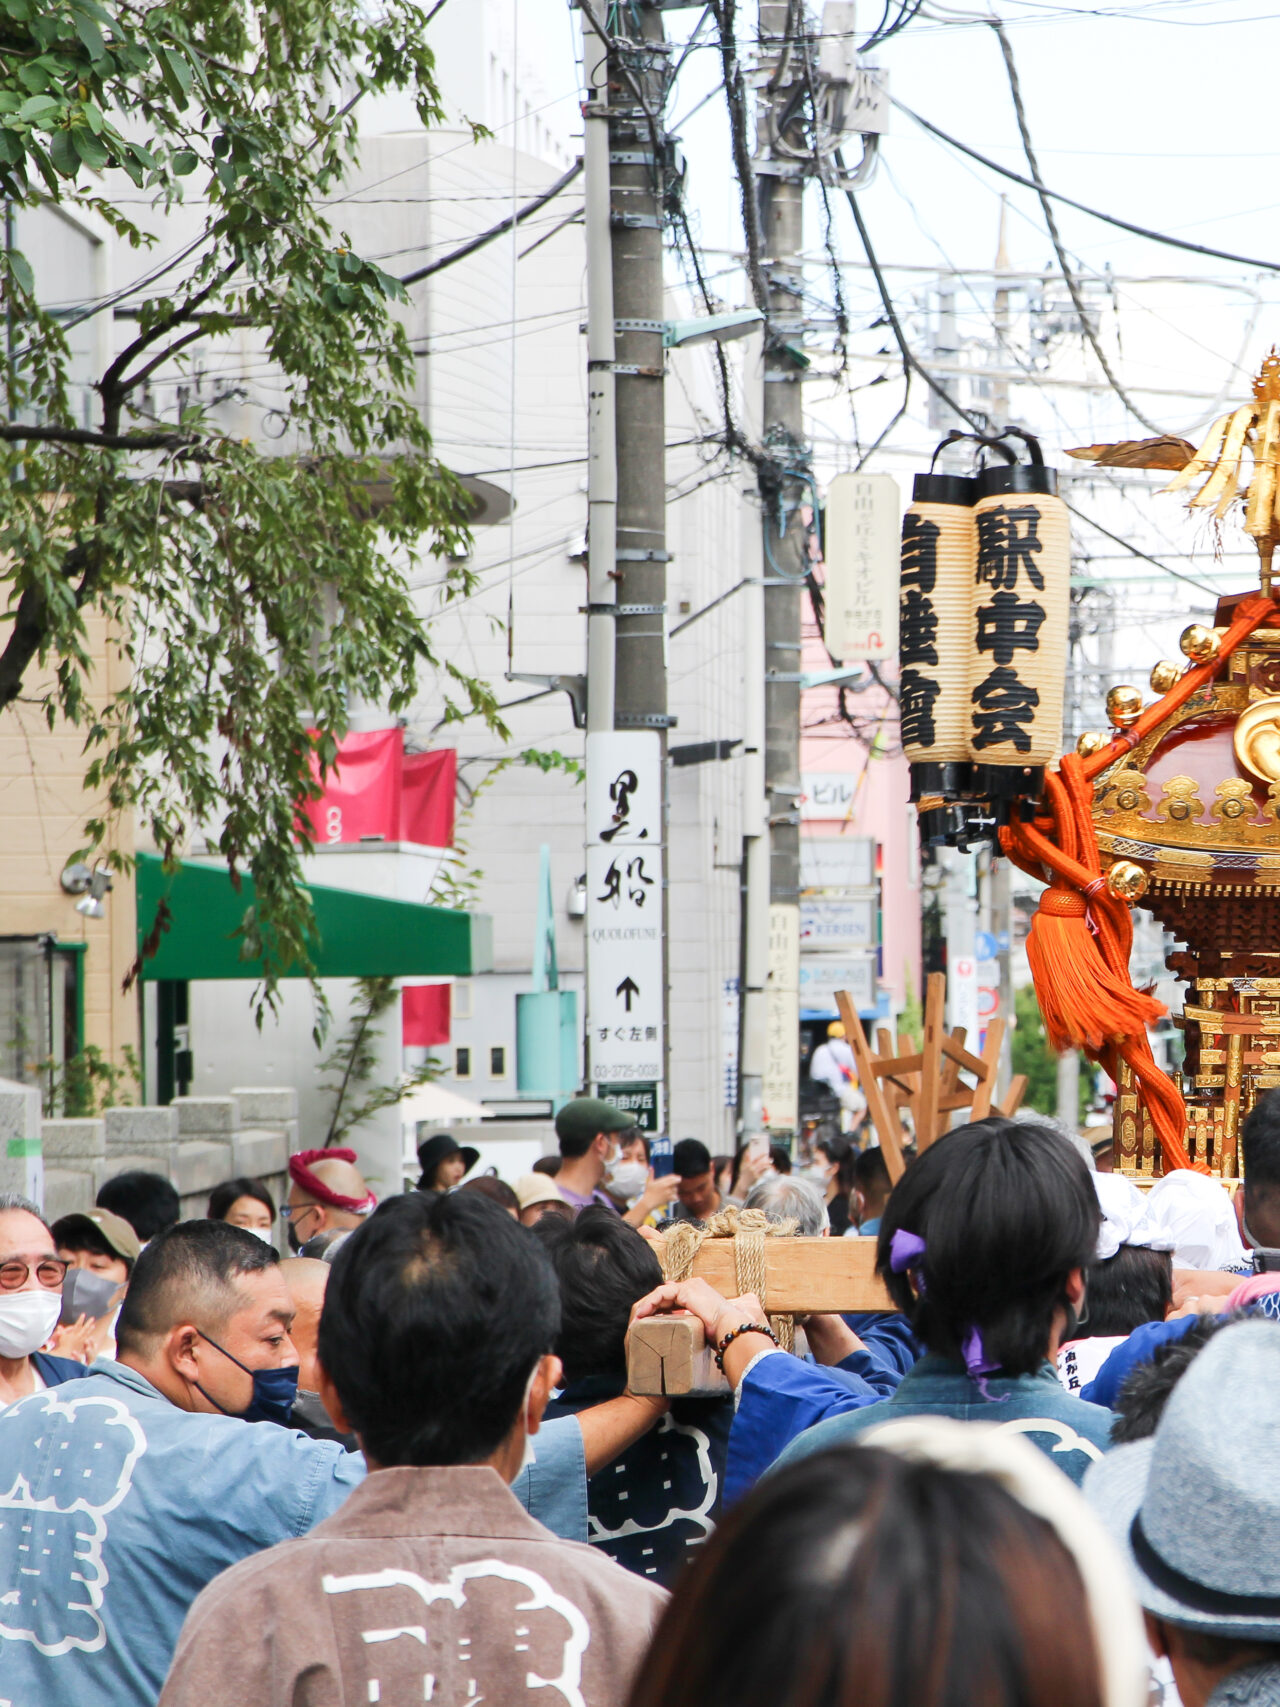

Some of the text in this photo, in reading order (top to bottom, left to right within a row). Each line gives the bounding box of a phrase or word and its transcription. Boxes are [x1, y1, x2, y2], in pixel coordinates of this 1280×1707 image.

[598, 1026, 658, 1042] すぐ左側
[1064, 1347, 1081, 1391] 由が丘
